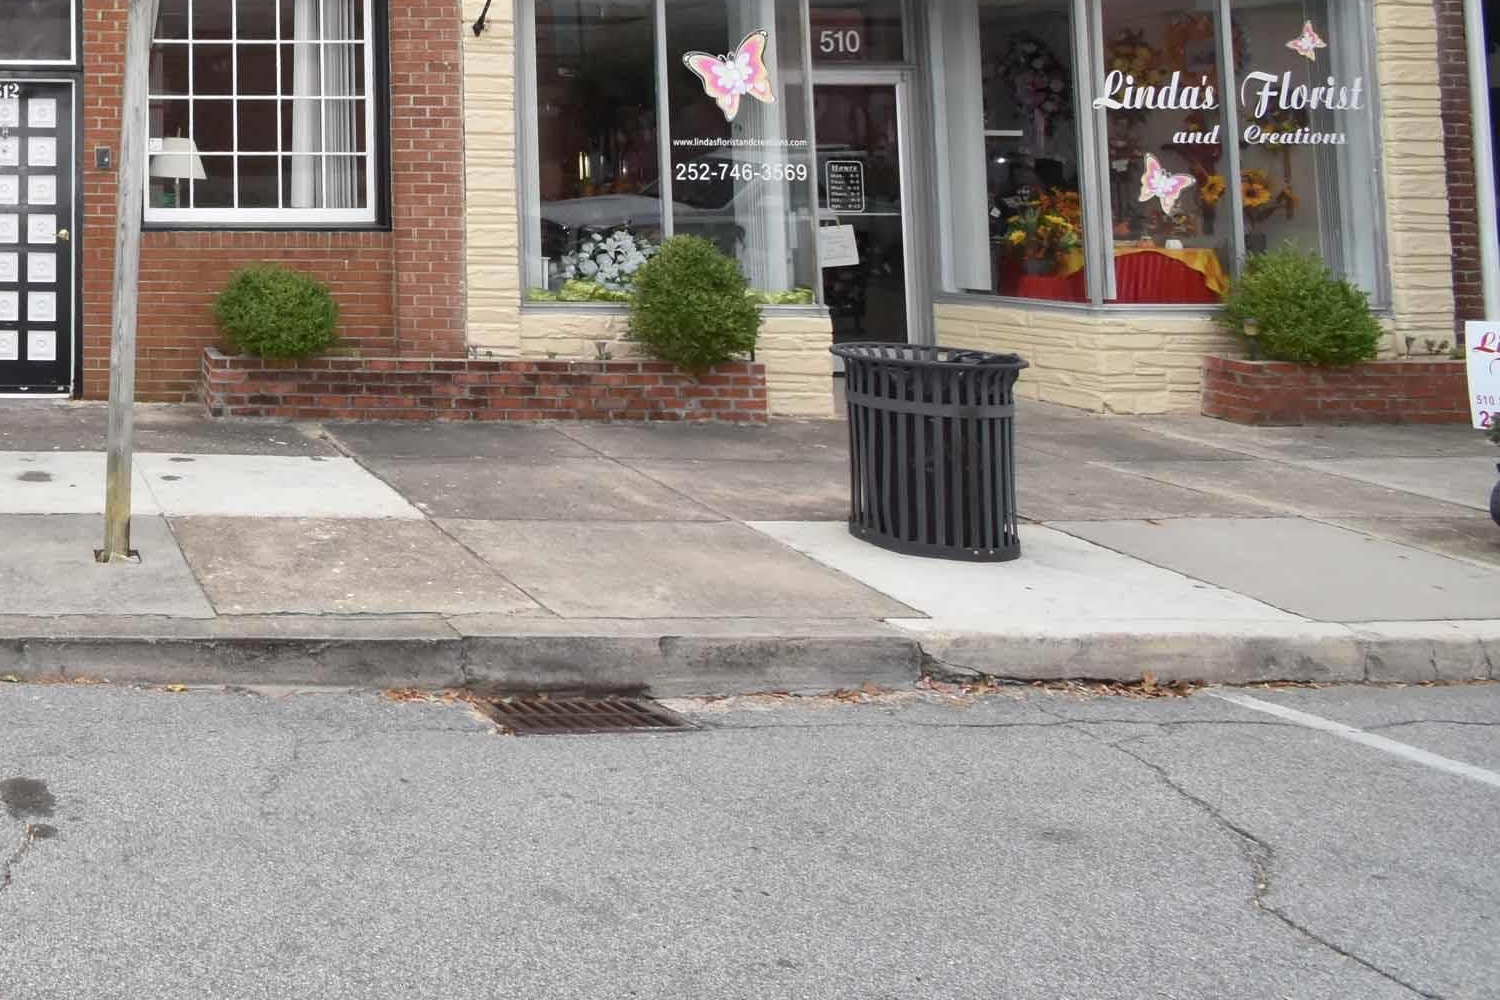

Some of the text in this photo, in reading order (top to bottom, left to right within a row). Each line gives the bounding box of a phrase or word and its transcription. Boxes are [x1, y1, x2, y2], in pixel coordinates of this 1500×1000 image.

[820, 30, 860, 52] 510
[1092, 70, 1364, 119] Linda's Florist
[1172, 125, 1346, 145] and Creations
[675, 163, 808, 181] 252-746-3569
